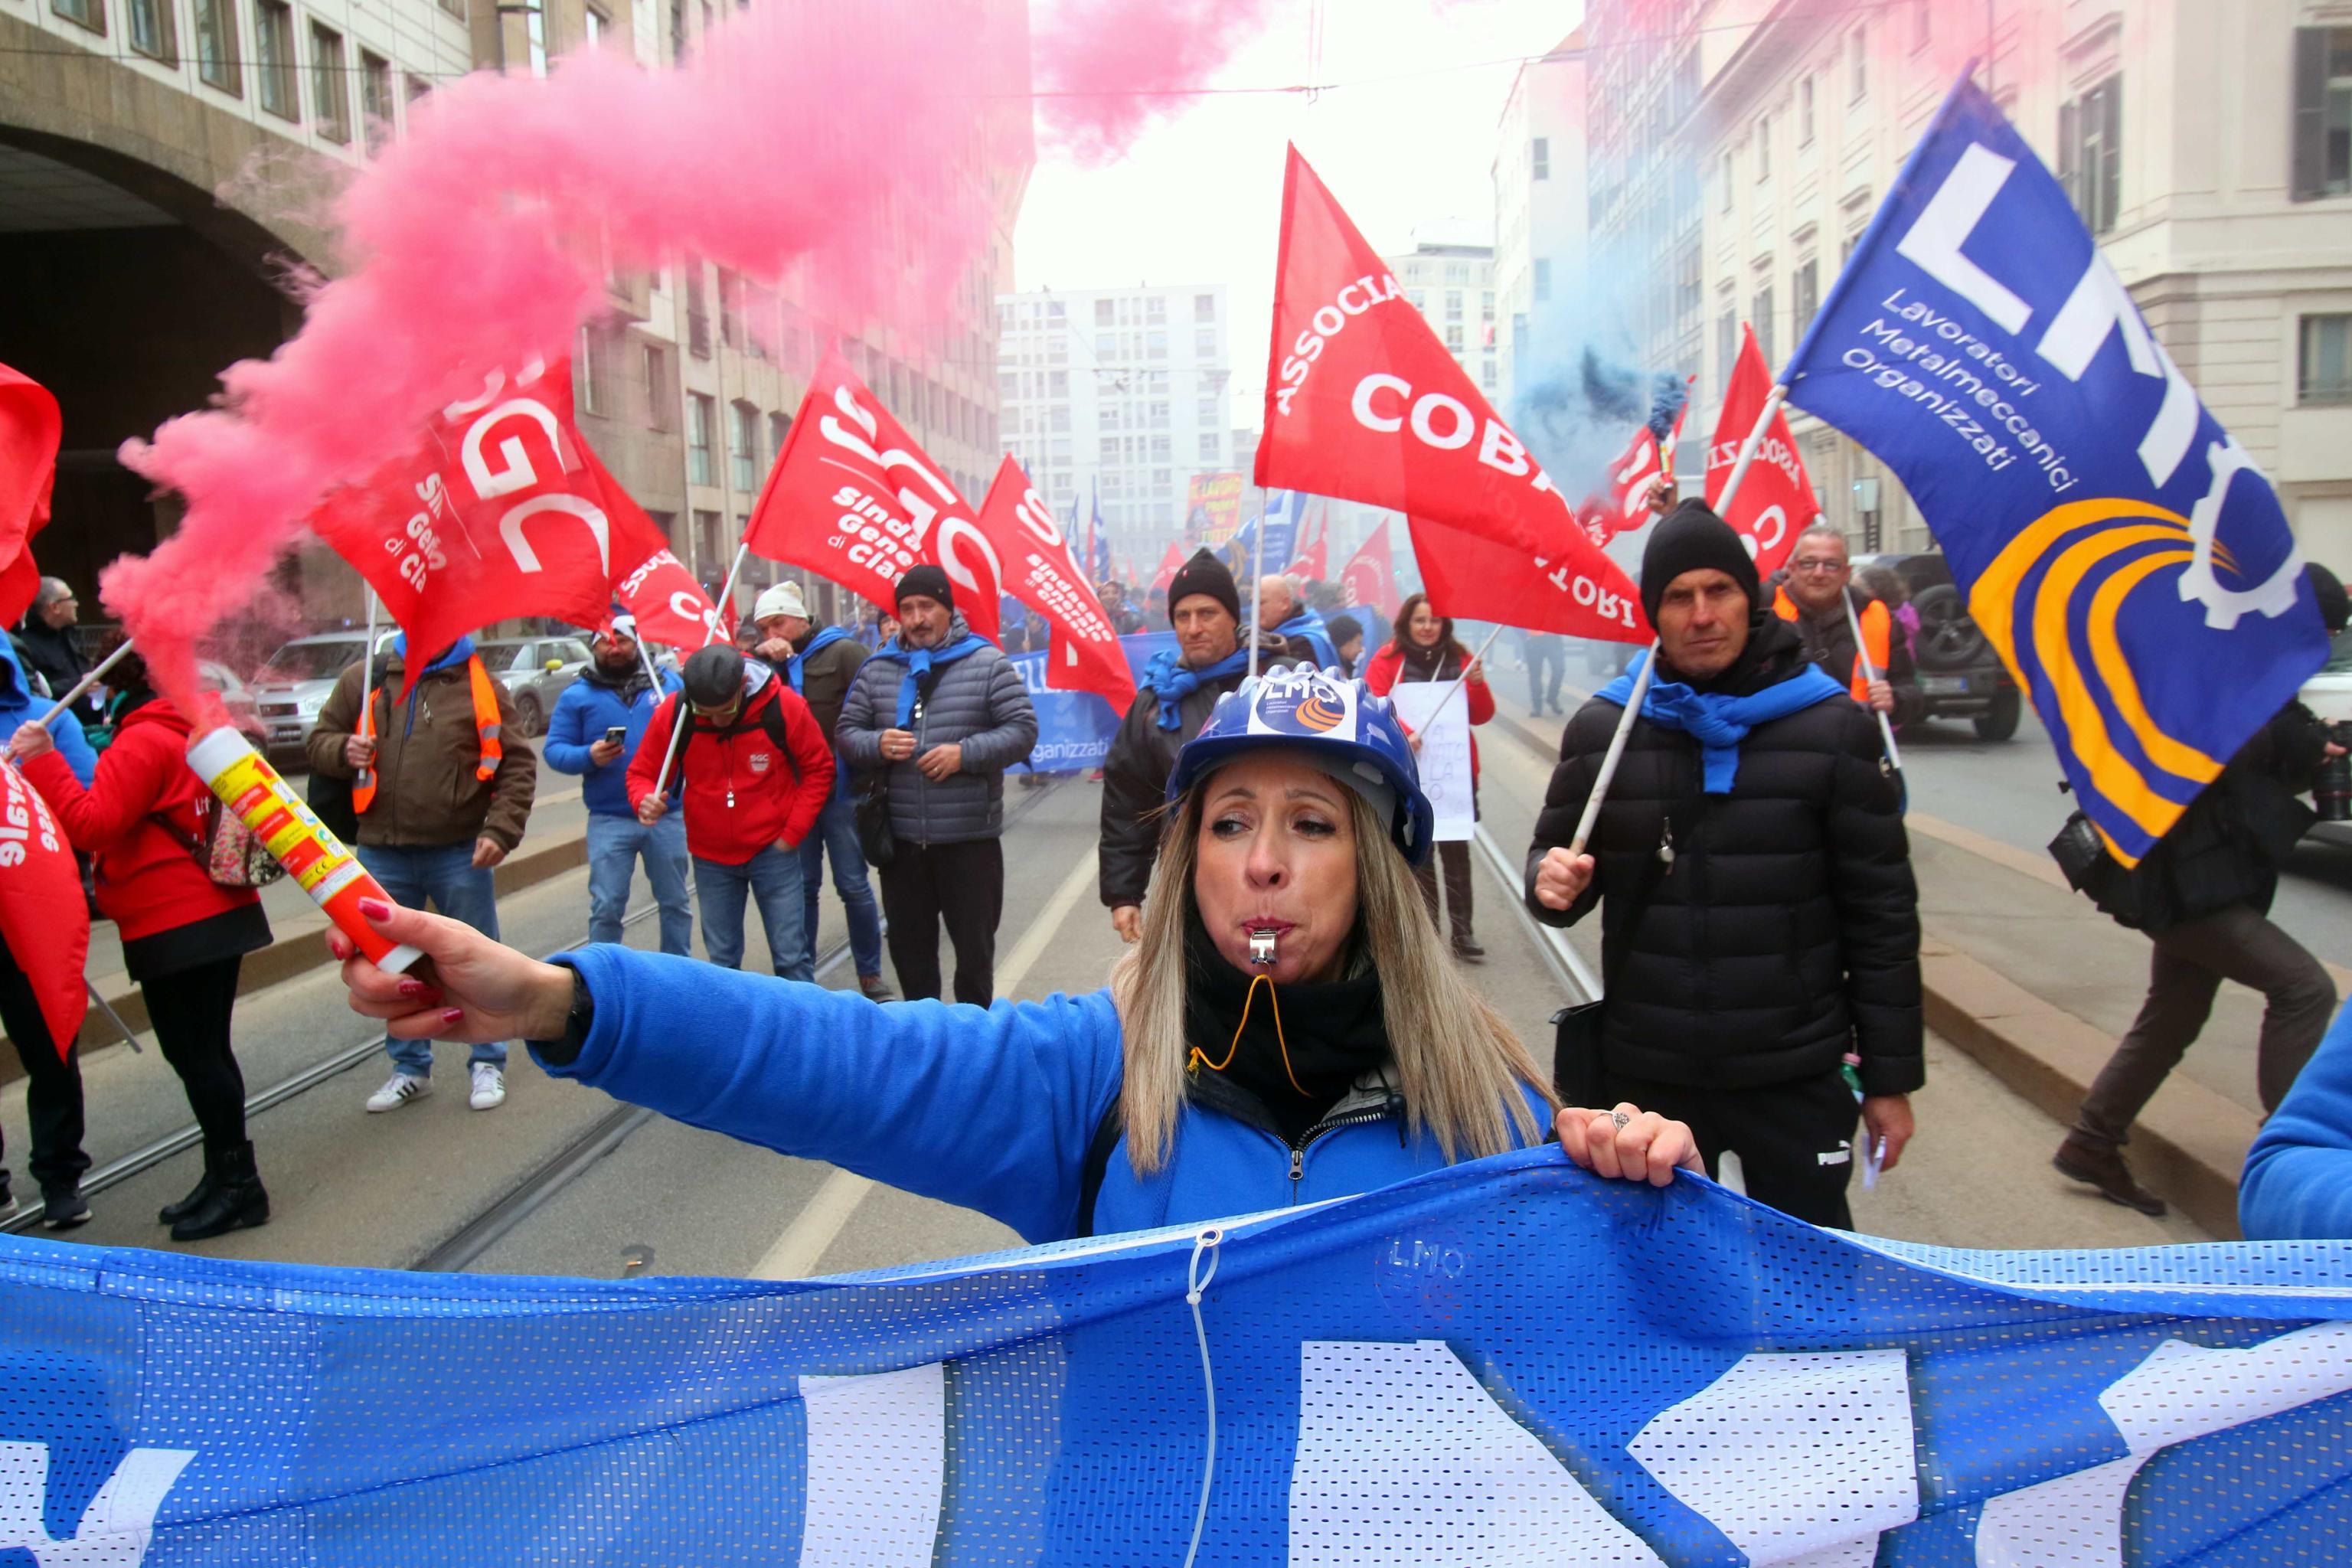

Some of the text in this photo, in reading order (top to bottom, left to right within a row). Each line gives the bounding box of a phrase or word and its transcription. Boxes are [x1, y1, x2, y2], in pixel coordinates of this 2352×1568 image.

[1276, 274, 1407, 417] ASSOCIA
[1860, 318, 2079, 493] Metalmeccanici
[1881, 288, 2041, 397] Lavoratori
[1842, 348, 2017, 472] Organizzati
